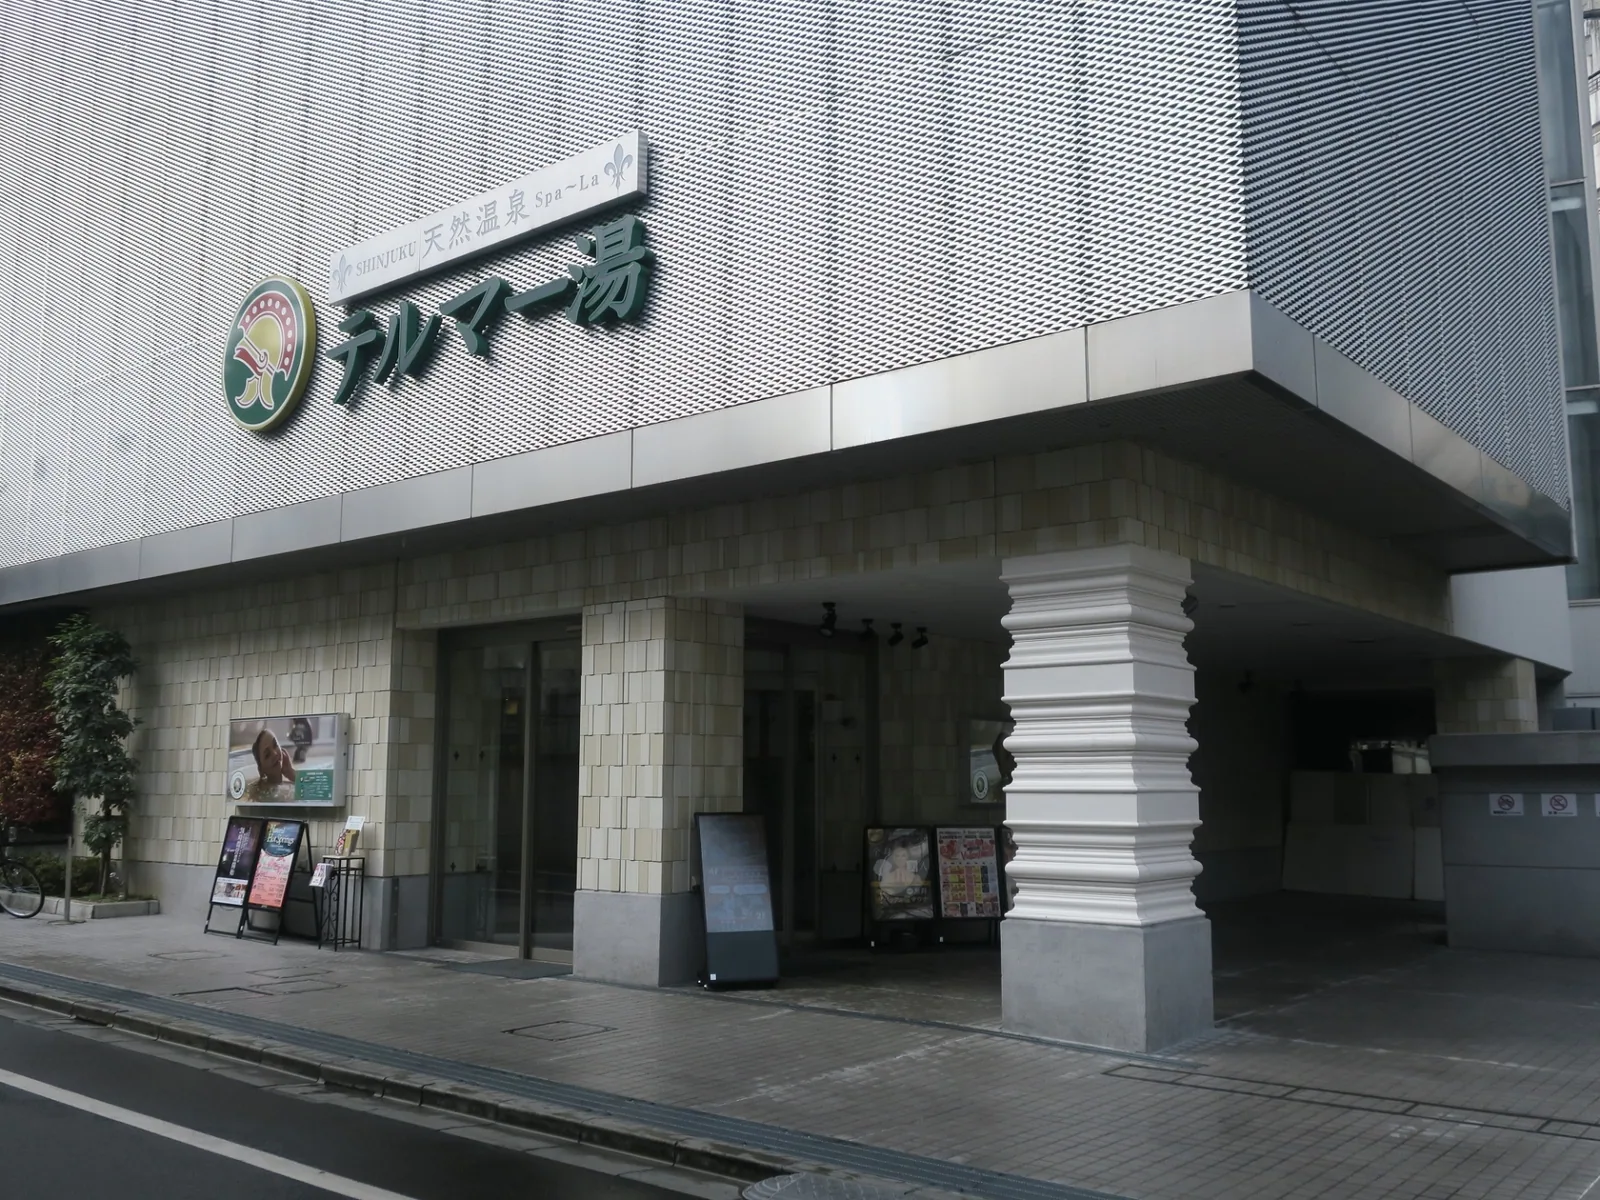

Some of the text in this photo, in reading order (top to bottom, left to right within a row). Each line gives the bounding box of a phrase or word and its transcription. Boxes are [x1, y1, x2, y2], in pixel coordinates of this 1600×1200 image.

[355, 240, 418, 277] SHINJUKU
[421, 188, 531, 259] 天然温泉
[325, 214, 653, 404] テルマー湯
